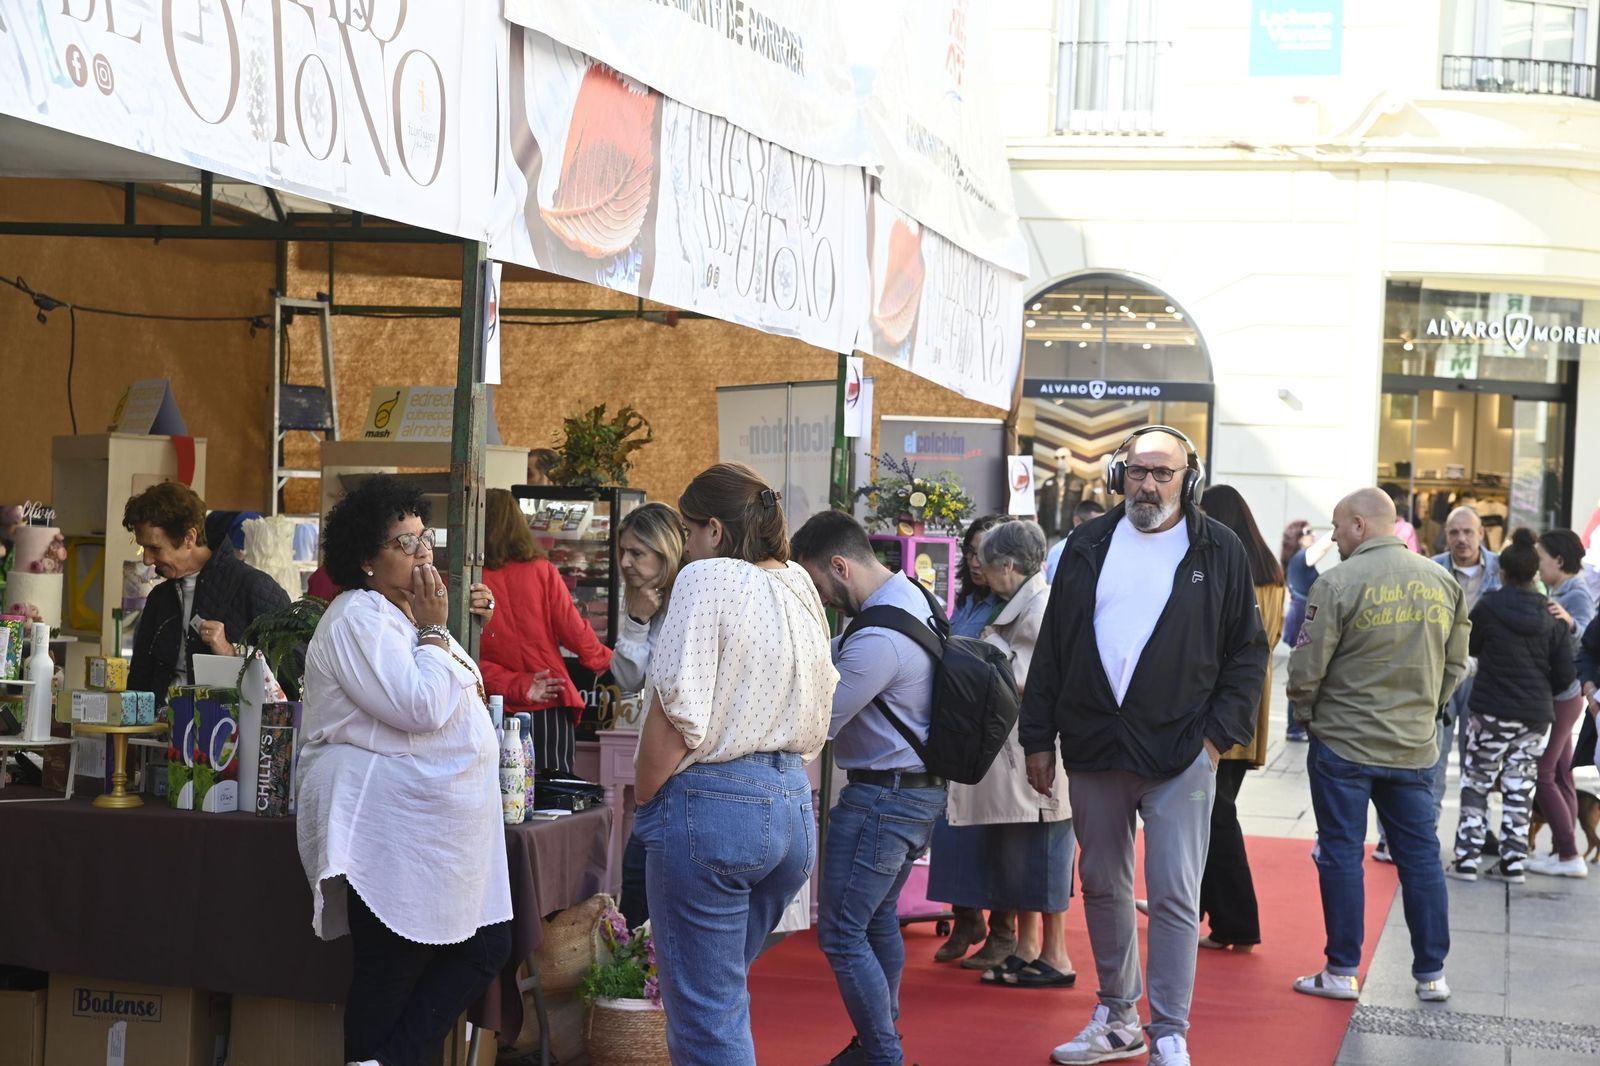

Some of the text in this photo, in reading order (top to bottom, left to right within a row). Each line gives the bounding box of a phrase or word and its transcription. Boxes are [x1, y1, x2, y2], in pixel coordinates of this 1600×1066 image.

[1427, 318, 1500, 340] ALVARO
[1040, 384, 1088, 394] ALVARO
[1107, 386, 1161, 396] MORENO
[364, 429, 391, 438] mash
[1365, 584, 1407, 605] Utah
[1354, 607, 1393, 630] Salt
[257, 734, 273, 811] CHILLY'S
[77, 988, 157, 1018] Bodense
